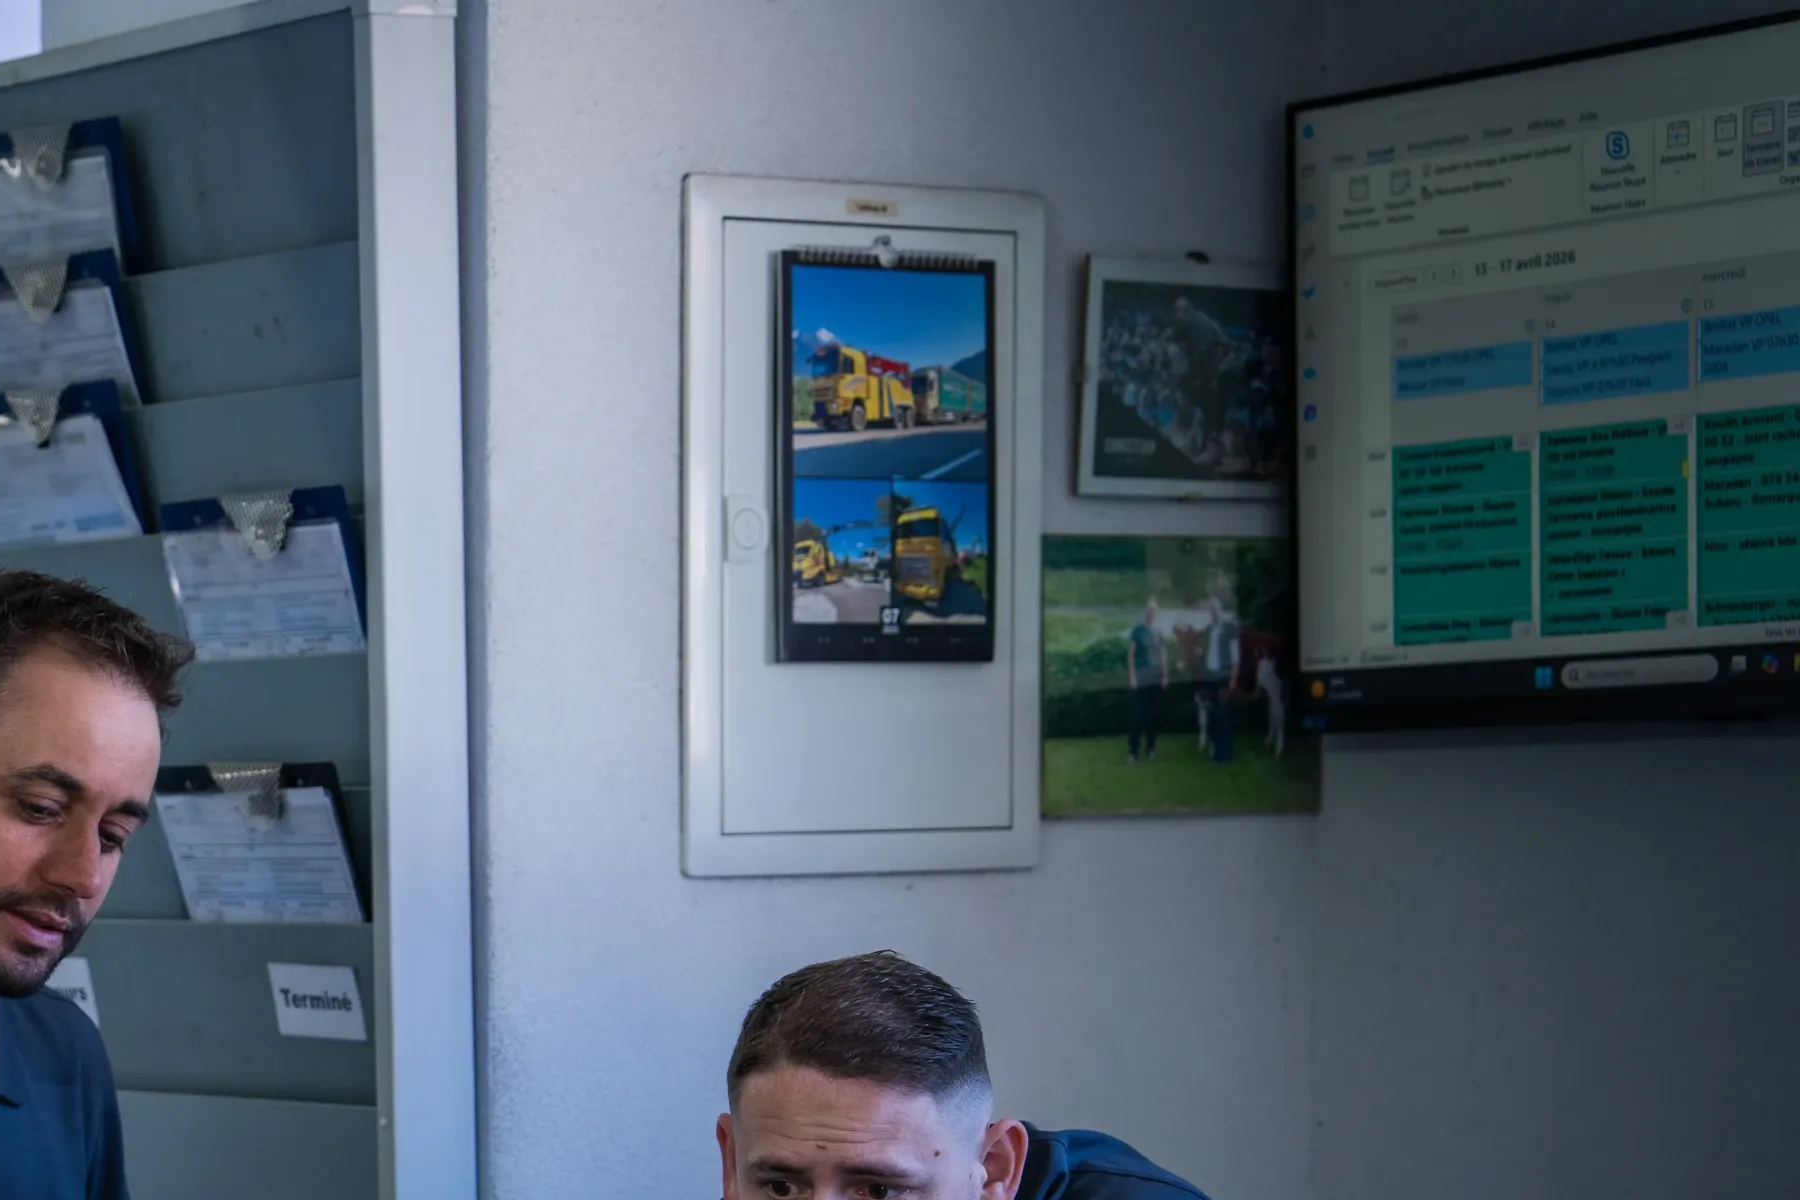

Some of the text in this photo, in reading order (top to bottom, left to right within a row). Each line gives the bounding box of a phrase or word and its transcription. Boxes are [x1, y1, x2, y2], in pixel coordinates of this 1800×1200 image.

[1515, 253, 1542, 271] avril
[1545, 249, 1577, 267] 2026
[1702, 265, 1746, 284] mercredi
[1756, 311, 1781, 327] OPEL
[1751, 337, 1766, 352] VP
[279, 986, 353, 1013] Terminé
